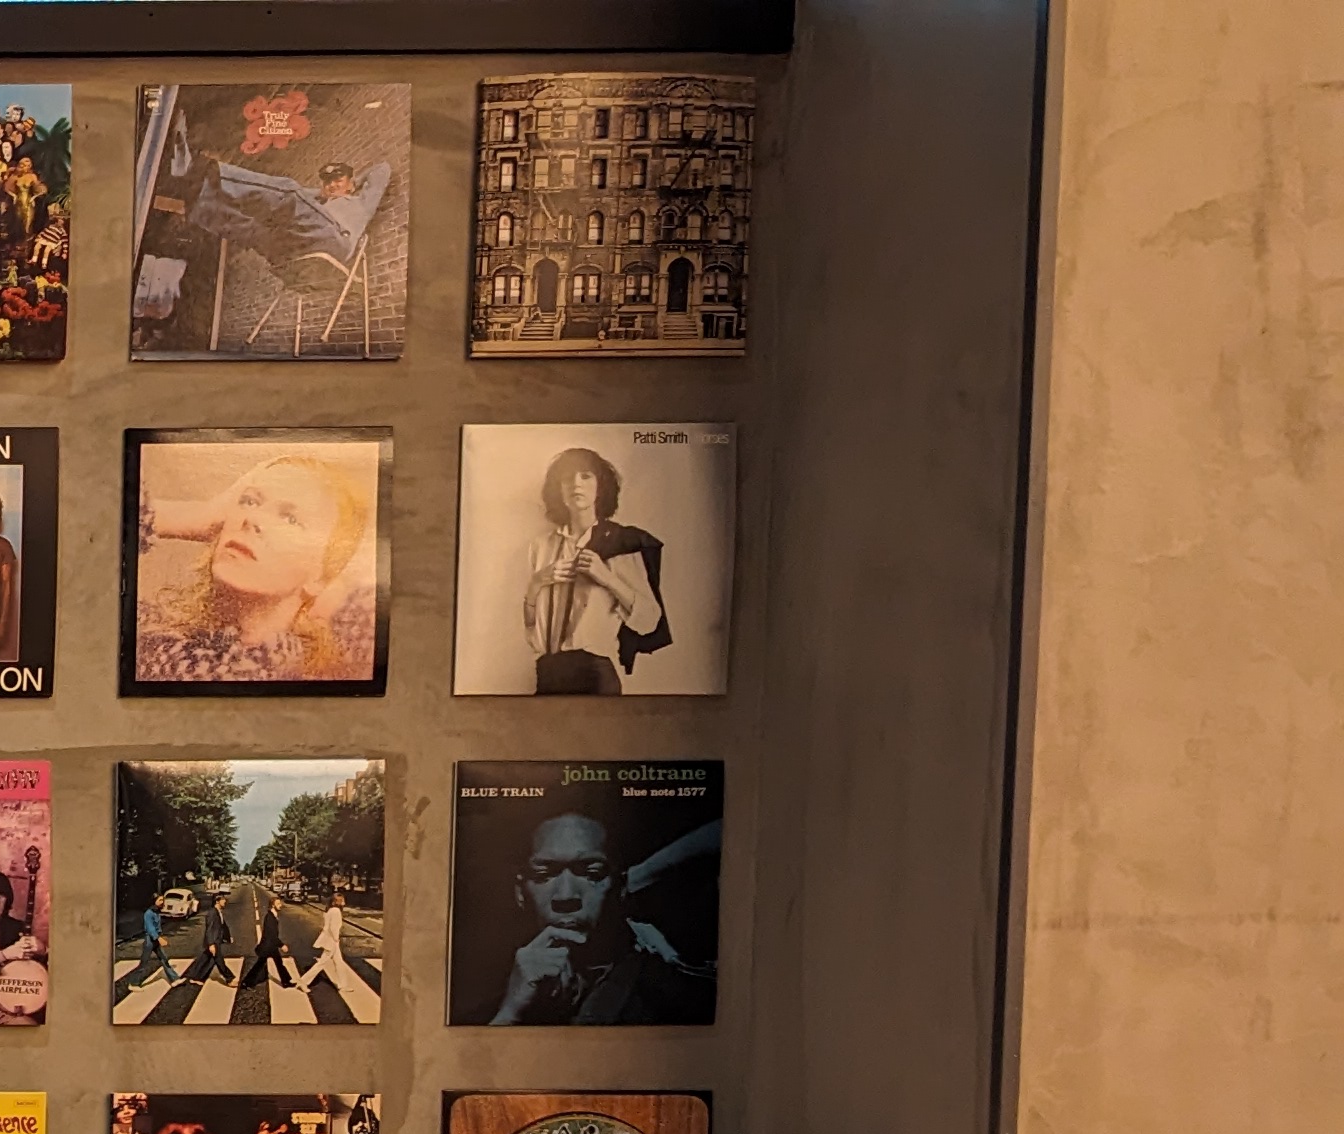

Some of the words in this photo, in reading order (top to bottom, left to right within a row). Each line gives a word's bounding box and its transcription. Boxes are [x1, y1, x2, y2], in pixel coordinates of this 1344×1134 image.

[263, 111, 290, 121] Truly
[259, 126, 293, 135] Citizen
[633, 432, 656, 444] Patti
[658, 432, 688, 444] Smith
[561, 765, 611, 785] john
[617, 765, 706, 781] coltrane
[461, 788, 498, 798] BLUE
[500, 788, 545, 798] TRAIN
[622, 787, 647, 797] blue
[650, 788, 675, 798] note
[677, 787, 707, 798] 1577
[0, 985, 41, 996] AIRPLANE
